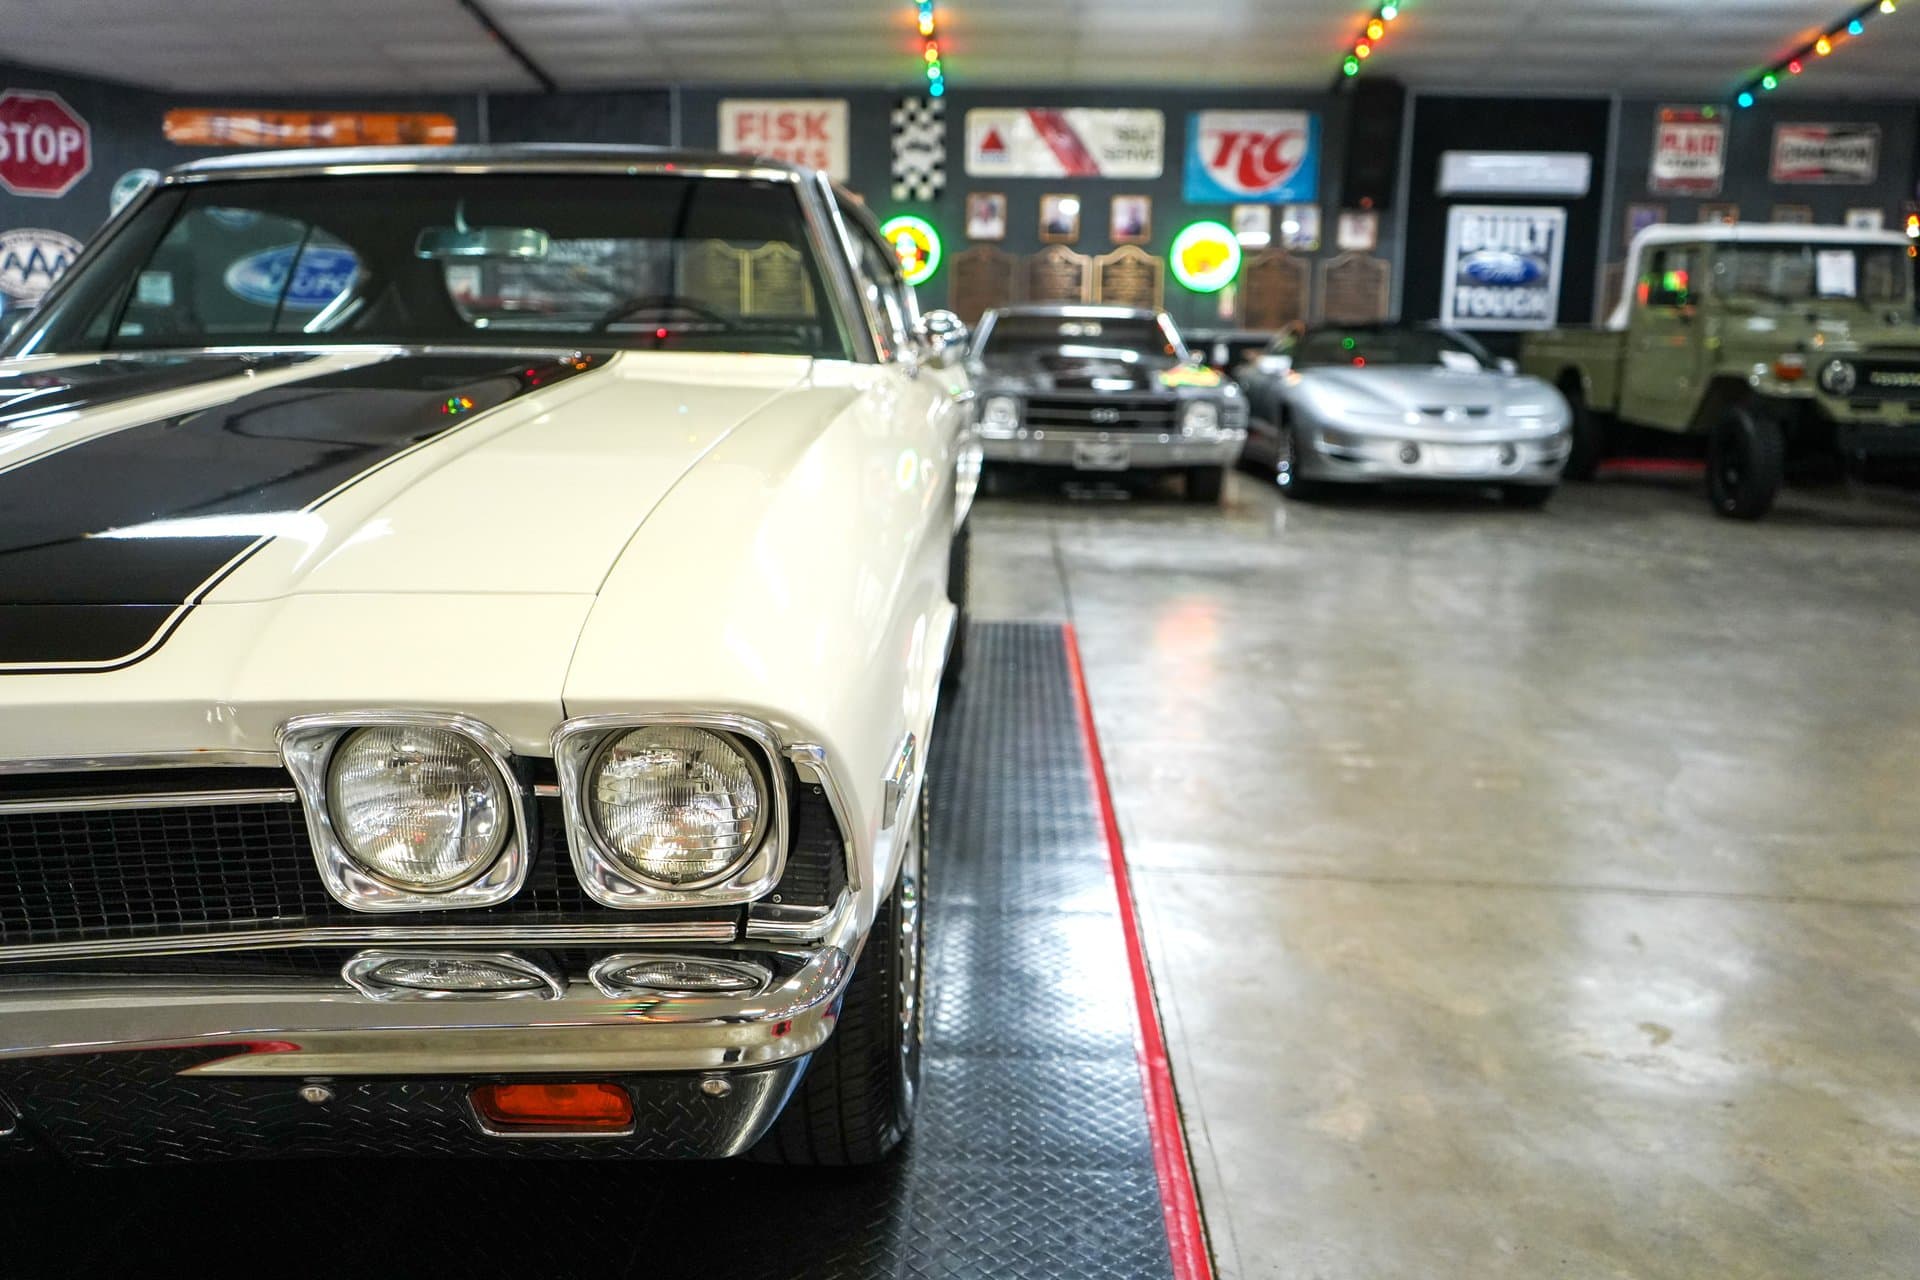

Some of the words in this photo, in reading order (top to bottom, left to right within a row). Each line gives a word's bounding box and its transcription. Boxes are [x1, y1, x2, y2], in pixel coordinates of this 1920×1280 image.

[736, 110, 830, 142] FISK
[1207, 130, 1303, 188] RC
[1458, 216, 1556, 252] BUILT
[1455, 286, 1549, 318] TOUGH
